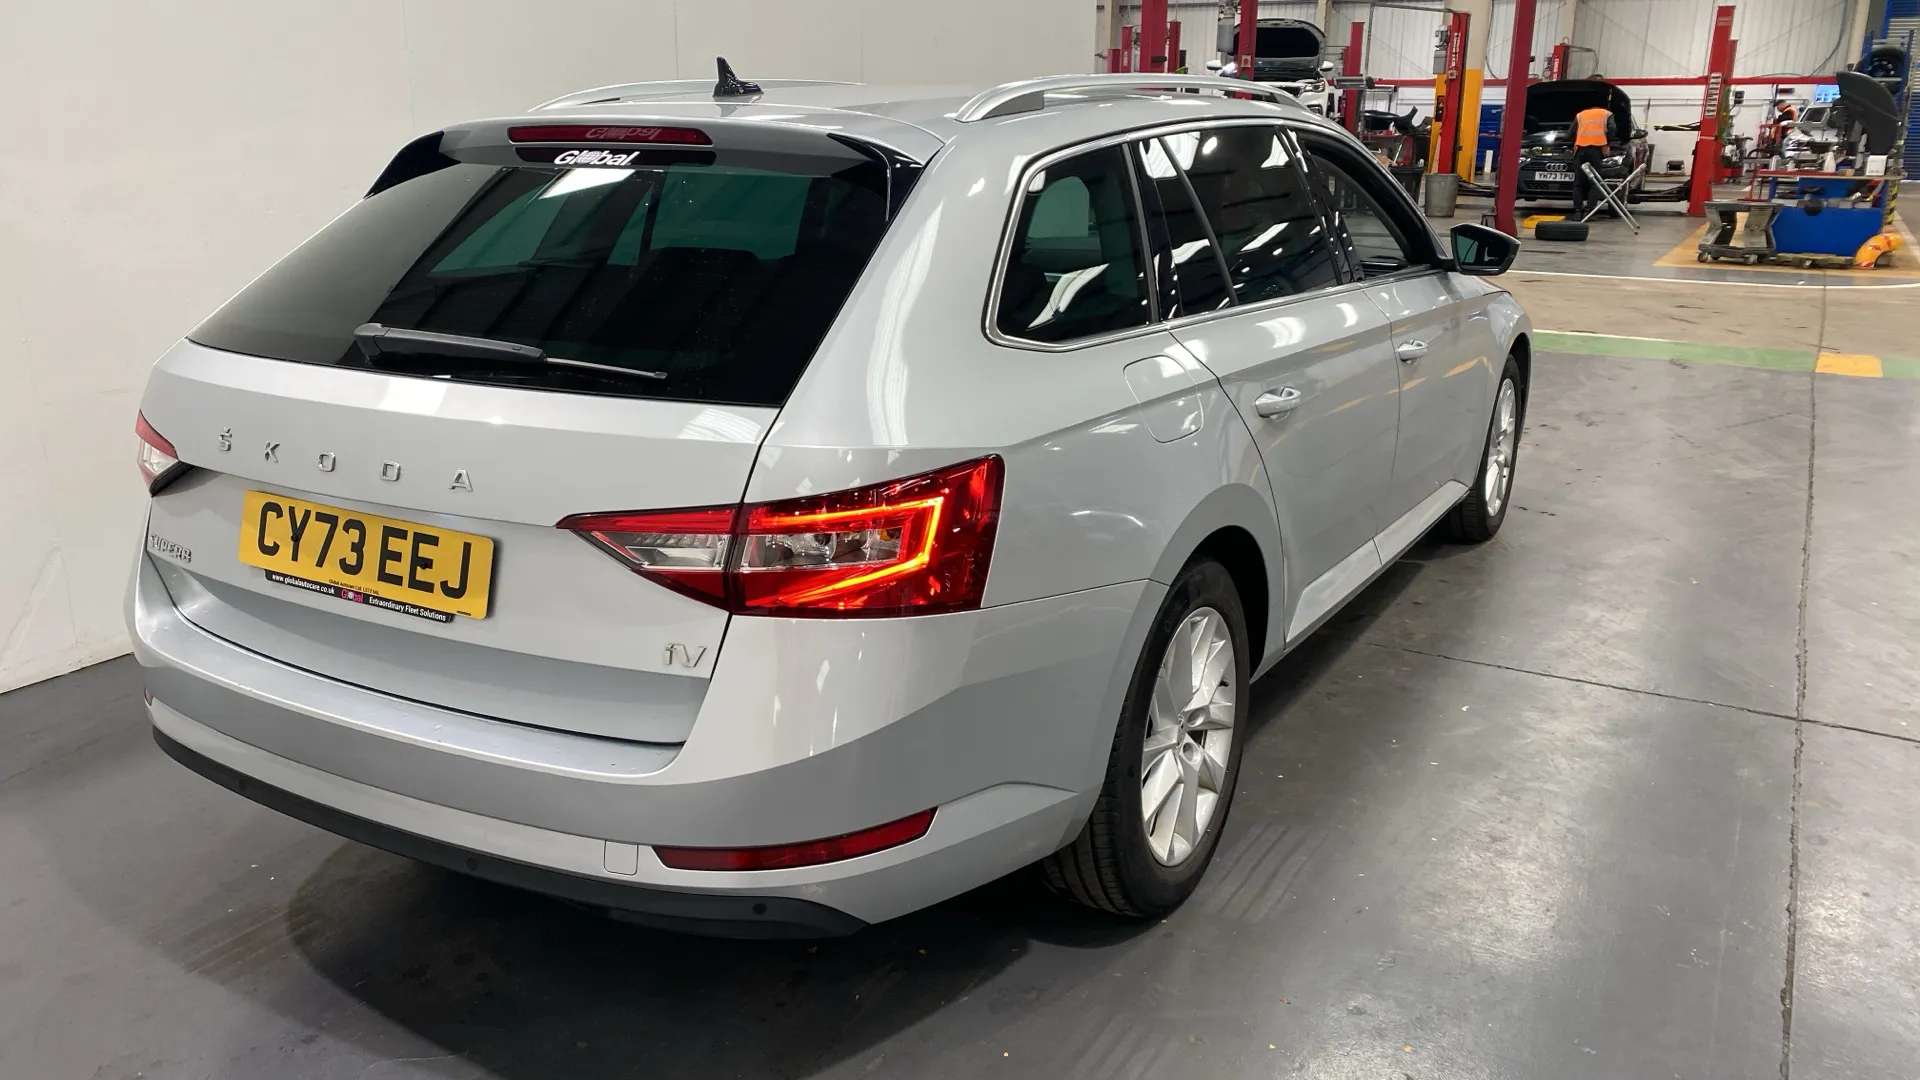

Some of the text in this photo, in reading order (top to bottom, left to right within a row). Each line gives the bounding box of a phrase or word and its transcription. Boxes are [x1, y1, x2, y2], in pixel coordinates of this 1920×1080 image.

[553, 150, 640, 166] Global
[216, 425, 474, 493] ŠKODA
[257, 501, 472, 600] CY73 EEJ
[368, 596, 405, 613] Extraordinary
[405, 604, 419, 616] Fleet
[419, 608, 446, 622] Solutions
